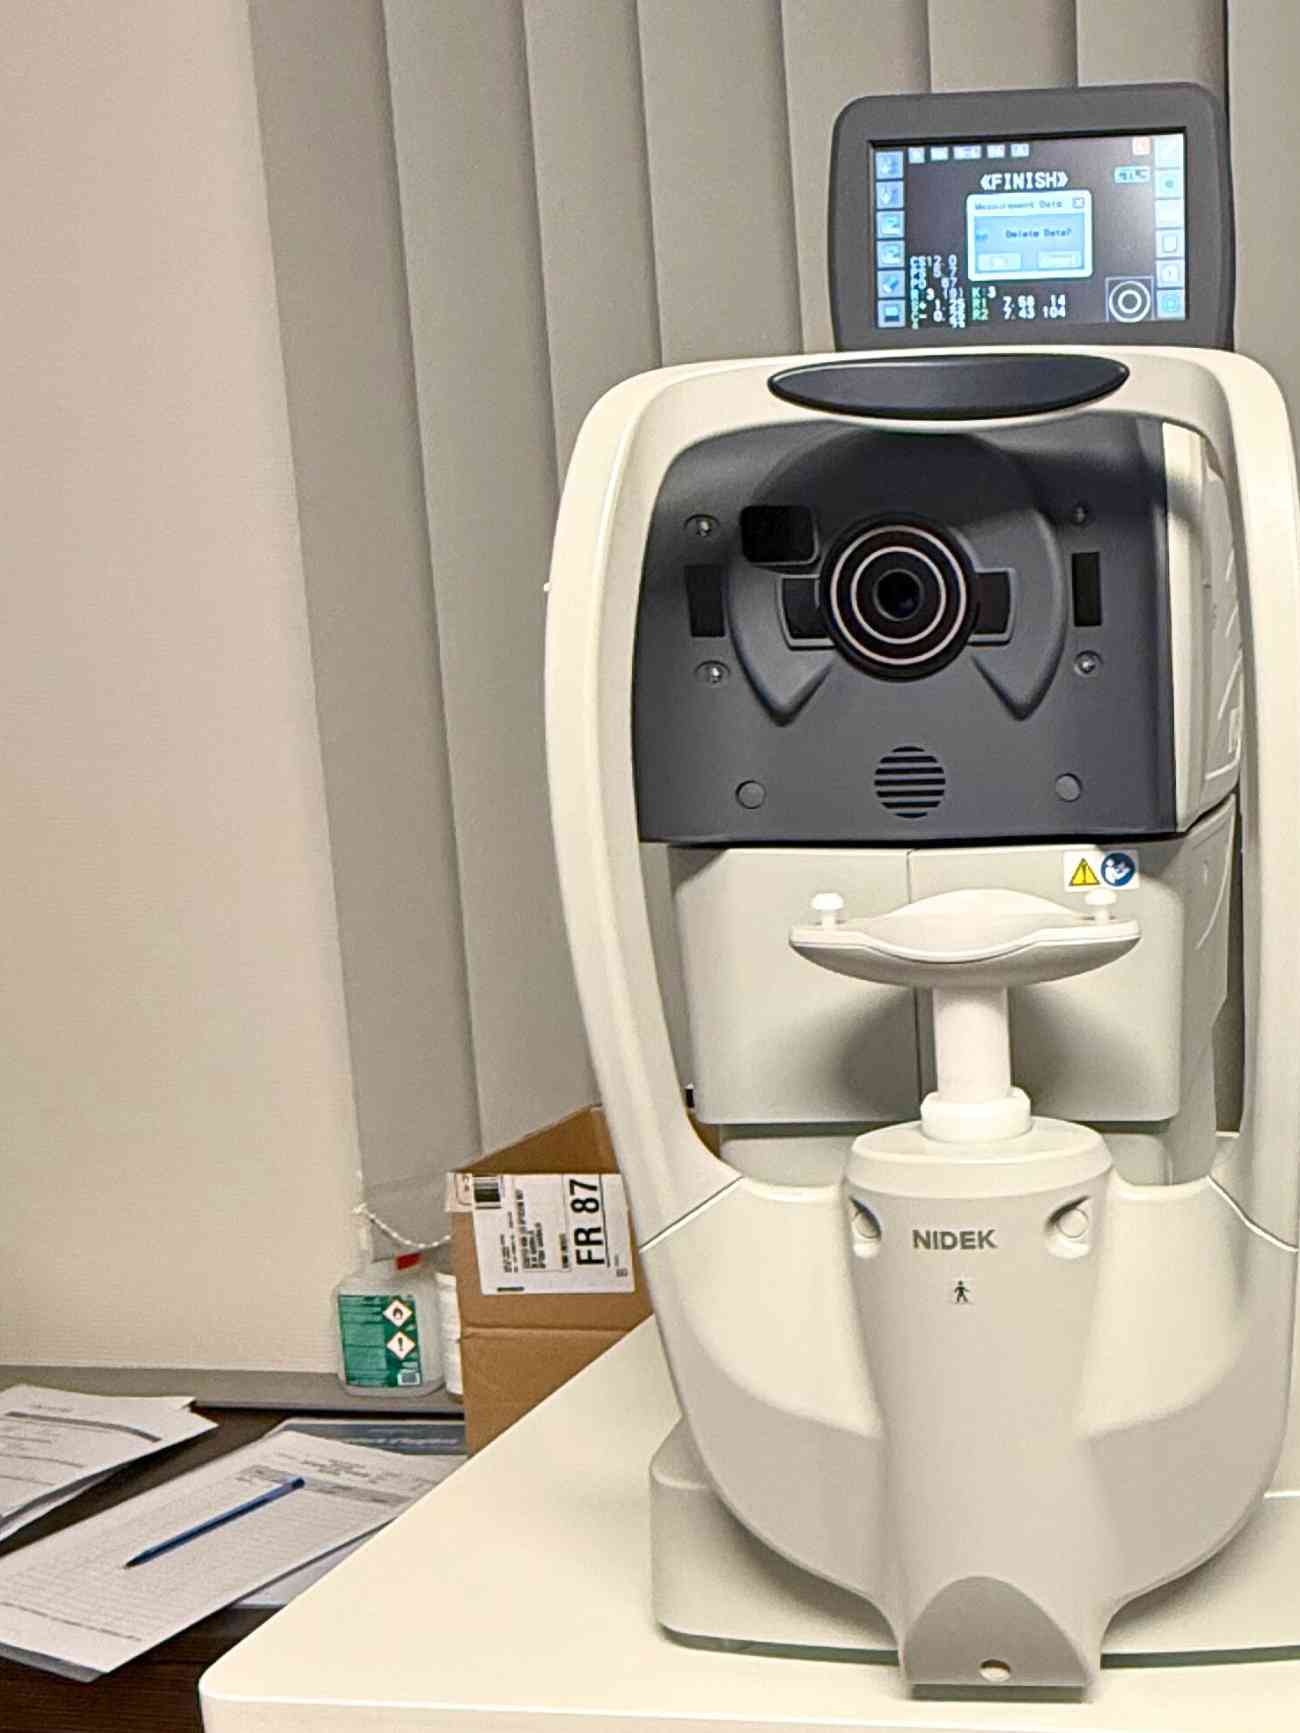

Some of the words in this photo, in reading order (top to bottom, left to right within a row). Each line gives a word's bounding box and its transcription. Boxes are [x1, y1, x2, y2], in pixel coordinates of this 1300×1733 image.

[569, 1179, 599, 1213] 87
[573, 1227, 605, 1265] FR
[912, 1229, 998, 1250] NIDEK
